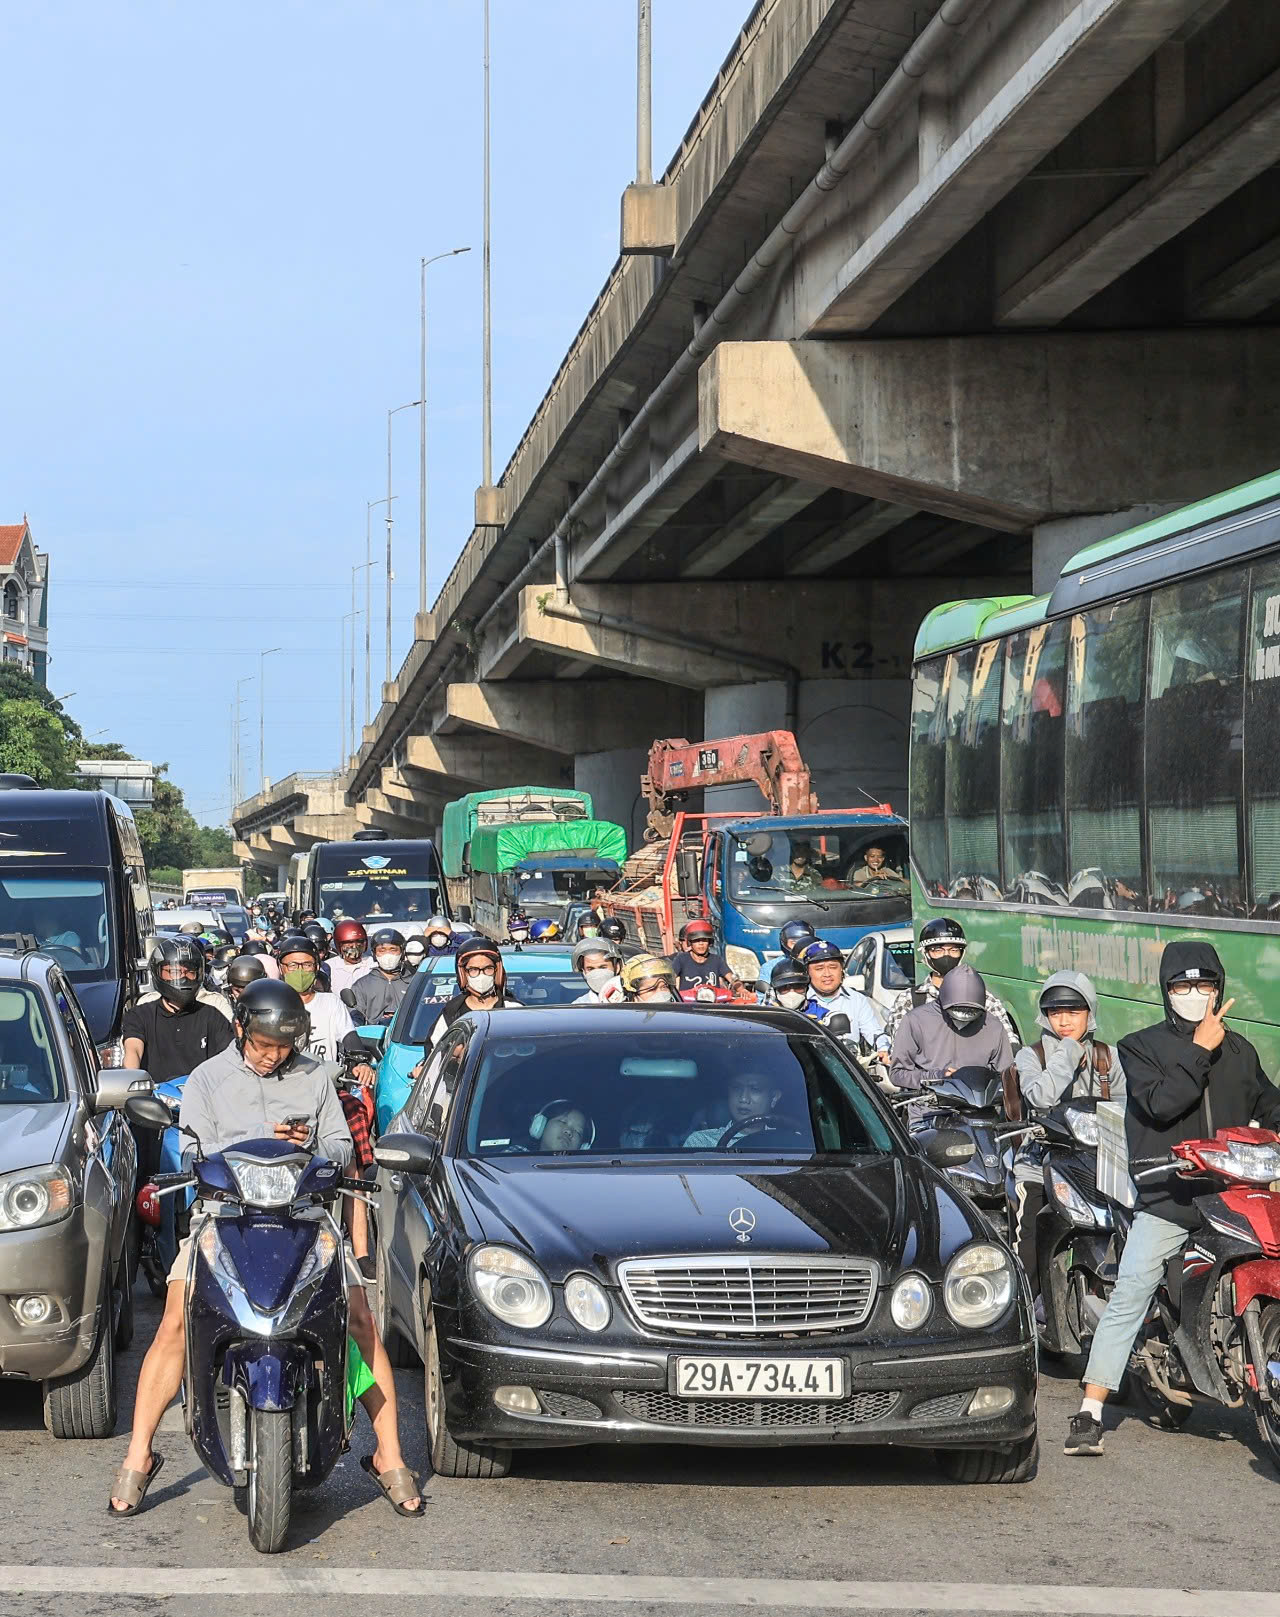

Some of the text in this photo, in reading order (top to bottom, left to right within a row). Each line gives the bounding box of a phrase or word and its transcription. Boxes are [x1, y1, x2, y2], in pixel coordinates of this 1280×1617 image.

[701, 752, 716, 766] 360
[424, 995, 454, 1004] TAXI
[1194, 1243, 1217, 1262] HONDA
[683, 1362, 834, 1393] 29A-734.41
